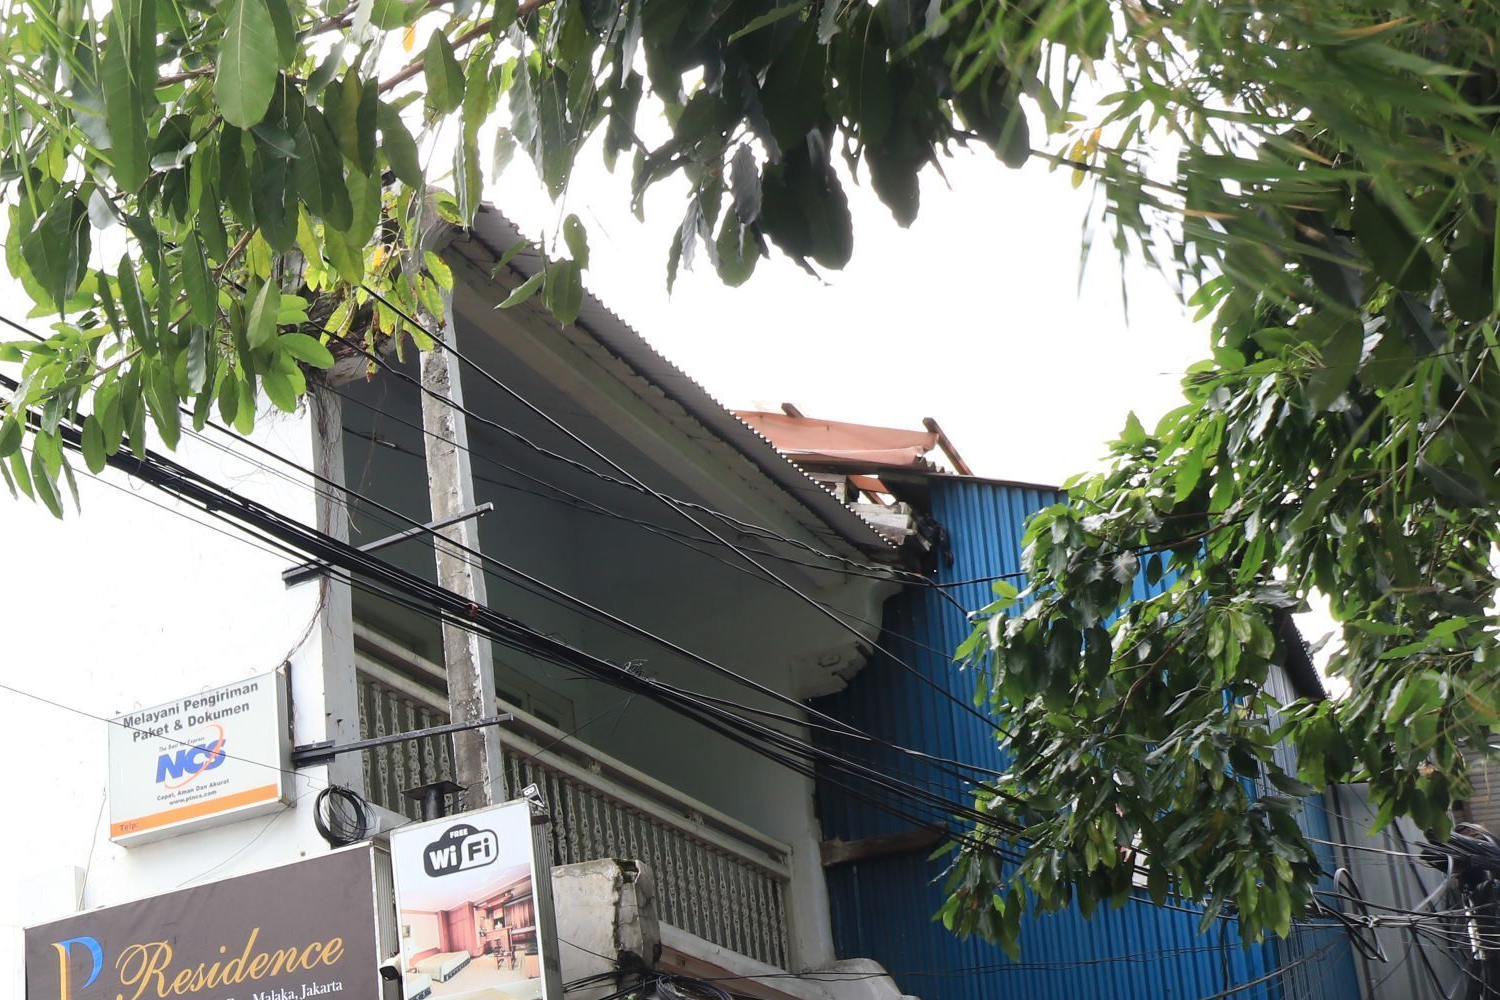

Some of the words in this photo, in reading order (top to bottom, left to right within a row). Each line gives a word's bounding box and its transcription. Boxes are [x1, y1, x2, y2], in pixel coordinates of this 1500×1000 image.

[123, 703, 180, 728] Melayani
[184, 682, 259, 711] Pengiriman
[132, 722, 169, 742] Paket
[173, 719, 183, 731] &
[188, 702, 250, 727] Dokumen
[156, 739, 226, 783] NCS
[177, 787, 195, 797] Aman
[195, 783, 208, 792] Dan
[209, 778, 230, 788] Akurat
[449, 828, 468, 840] FREE
